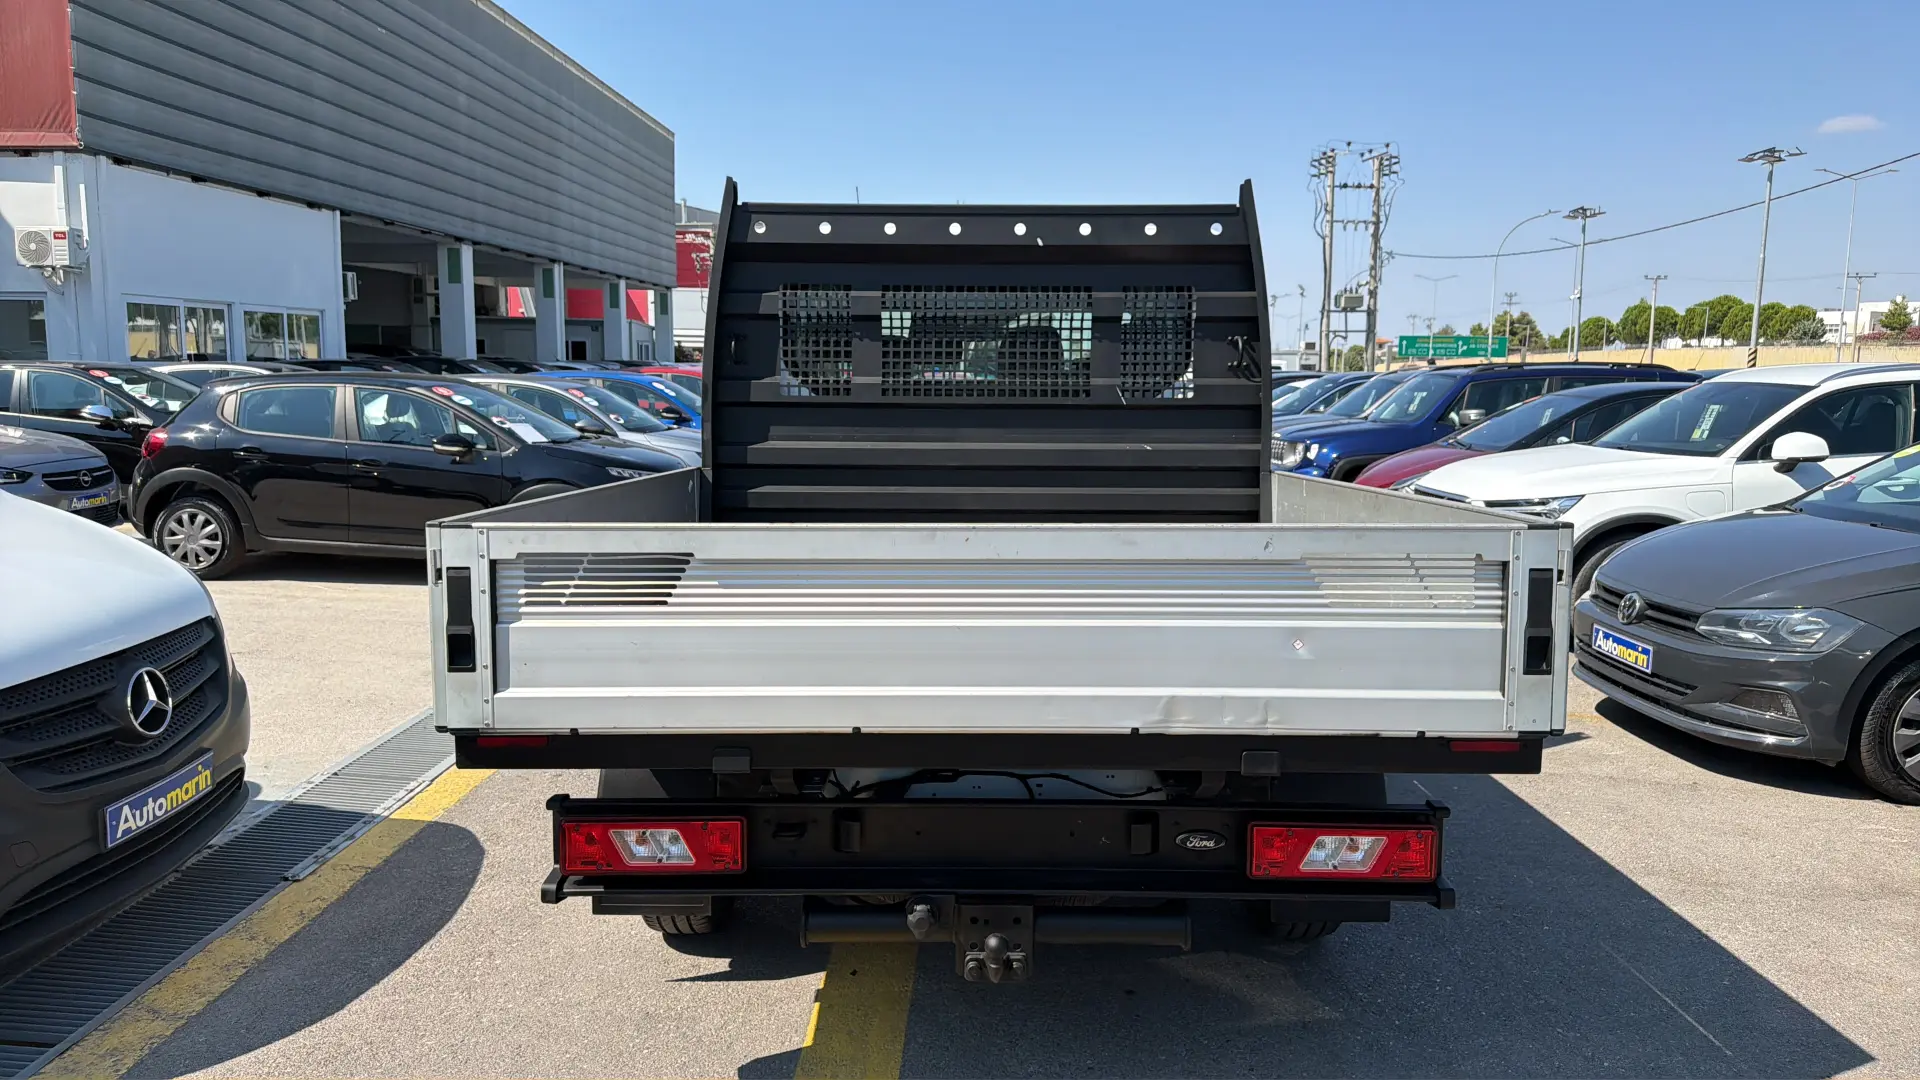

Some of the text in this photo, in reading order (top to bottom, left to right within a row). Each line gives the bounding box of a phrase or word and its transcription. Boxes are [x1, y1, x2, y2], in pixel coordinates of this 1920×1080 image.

[1595, 630, 1648, 668] Automarin
[115, 765, 213, 839] Automarin
[1186, 834, 1216, 847] Ford
